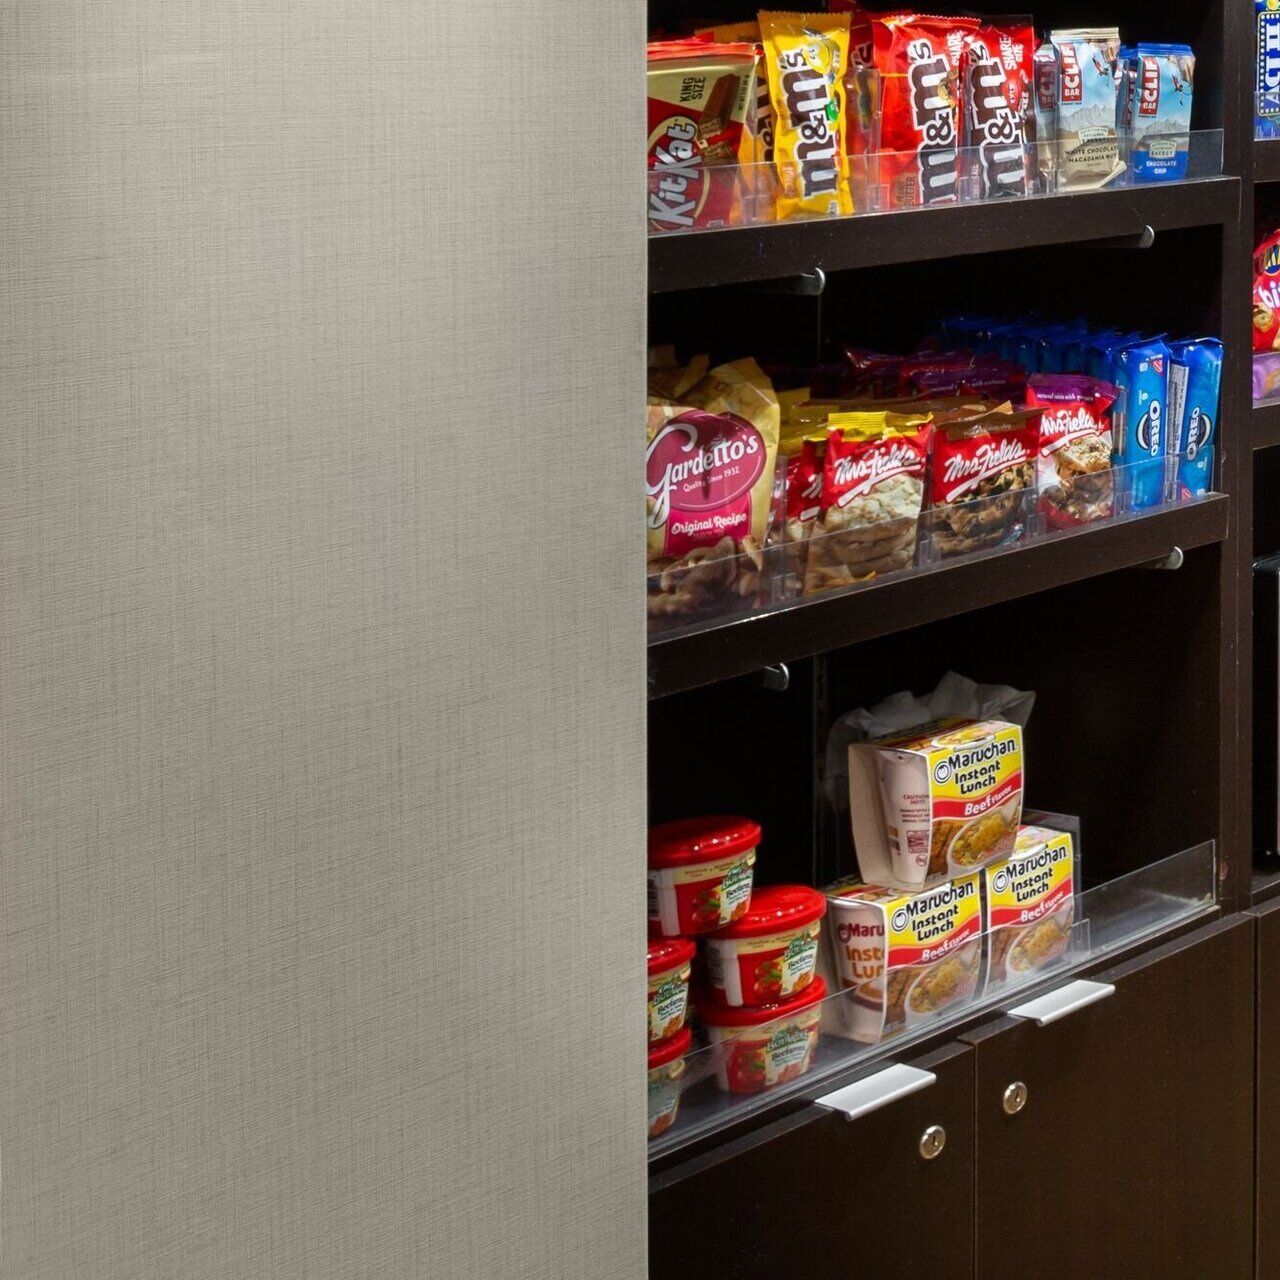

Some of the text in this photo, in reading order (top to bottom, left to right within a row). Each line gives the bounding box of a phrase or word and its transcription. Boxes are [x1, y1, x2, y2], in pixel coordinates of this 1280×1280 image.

[1000, 35, 1017, 70] SHARE
[1062, 45, 1081, 88] CLIF
[1143, 57, 1158, 102] CLIF
[679, 76, 695, 102] KING
[690, 75, 706, 100] SIZE
[1064, 88, 1080, 97] BAR
[1264, 55, 1280, 105] ACT
[1068, 154, 1105, 163] MACADAMIA
[1146, 160, 1178, 168] CHOCOLATE
[904, 175, 915, 207] BUTTER
[1149, 399, 1161, 457] OREO
[1186, 406, 1200, 462] OREO
[723, 466, 741, 478] 1932
[975, 438, 1027, 486] Fields
[646, 422, 760, 530] Gardetto's
[671, 512, 747, 537] Original Recipe
[948, 738, 1016, 771] Maruchan
[954, 760, 1001, 784] Instant
[960, 774, 997, 795] Lunch
[964, 794, 991, 816] Beef
[1005, 845, 1067, 879] Maruchan
[1012, 867, 1053, 892] Instant
[1016, 882, 1049, 902] Lunch
[905, 880, 974, 917] Maruchan
[848, 922, 885, 938] Maru
[912, 904, 959, 931] Instant
[917, 919, 954, 941] Lunch
